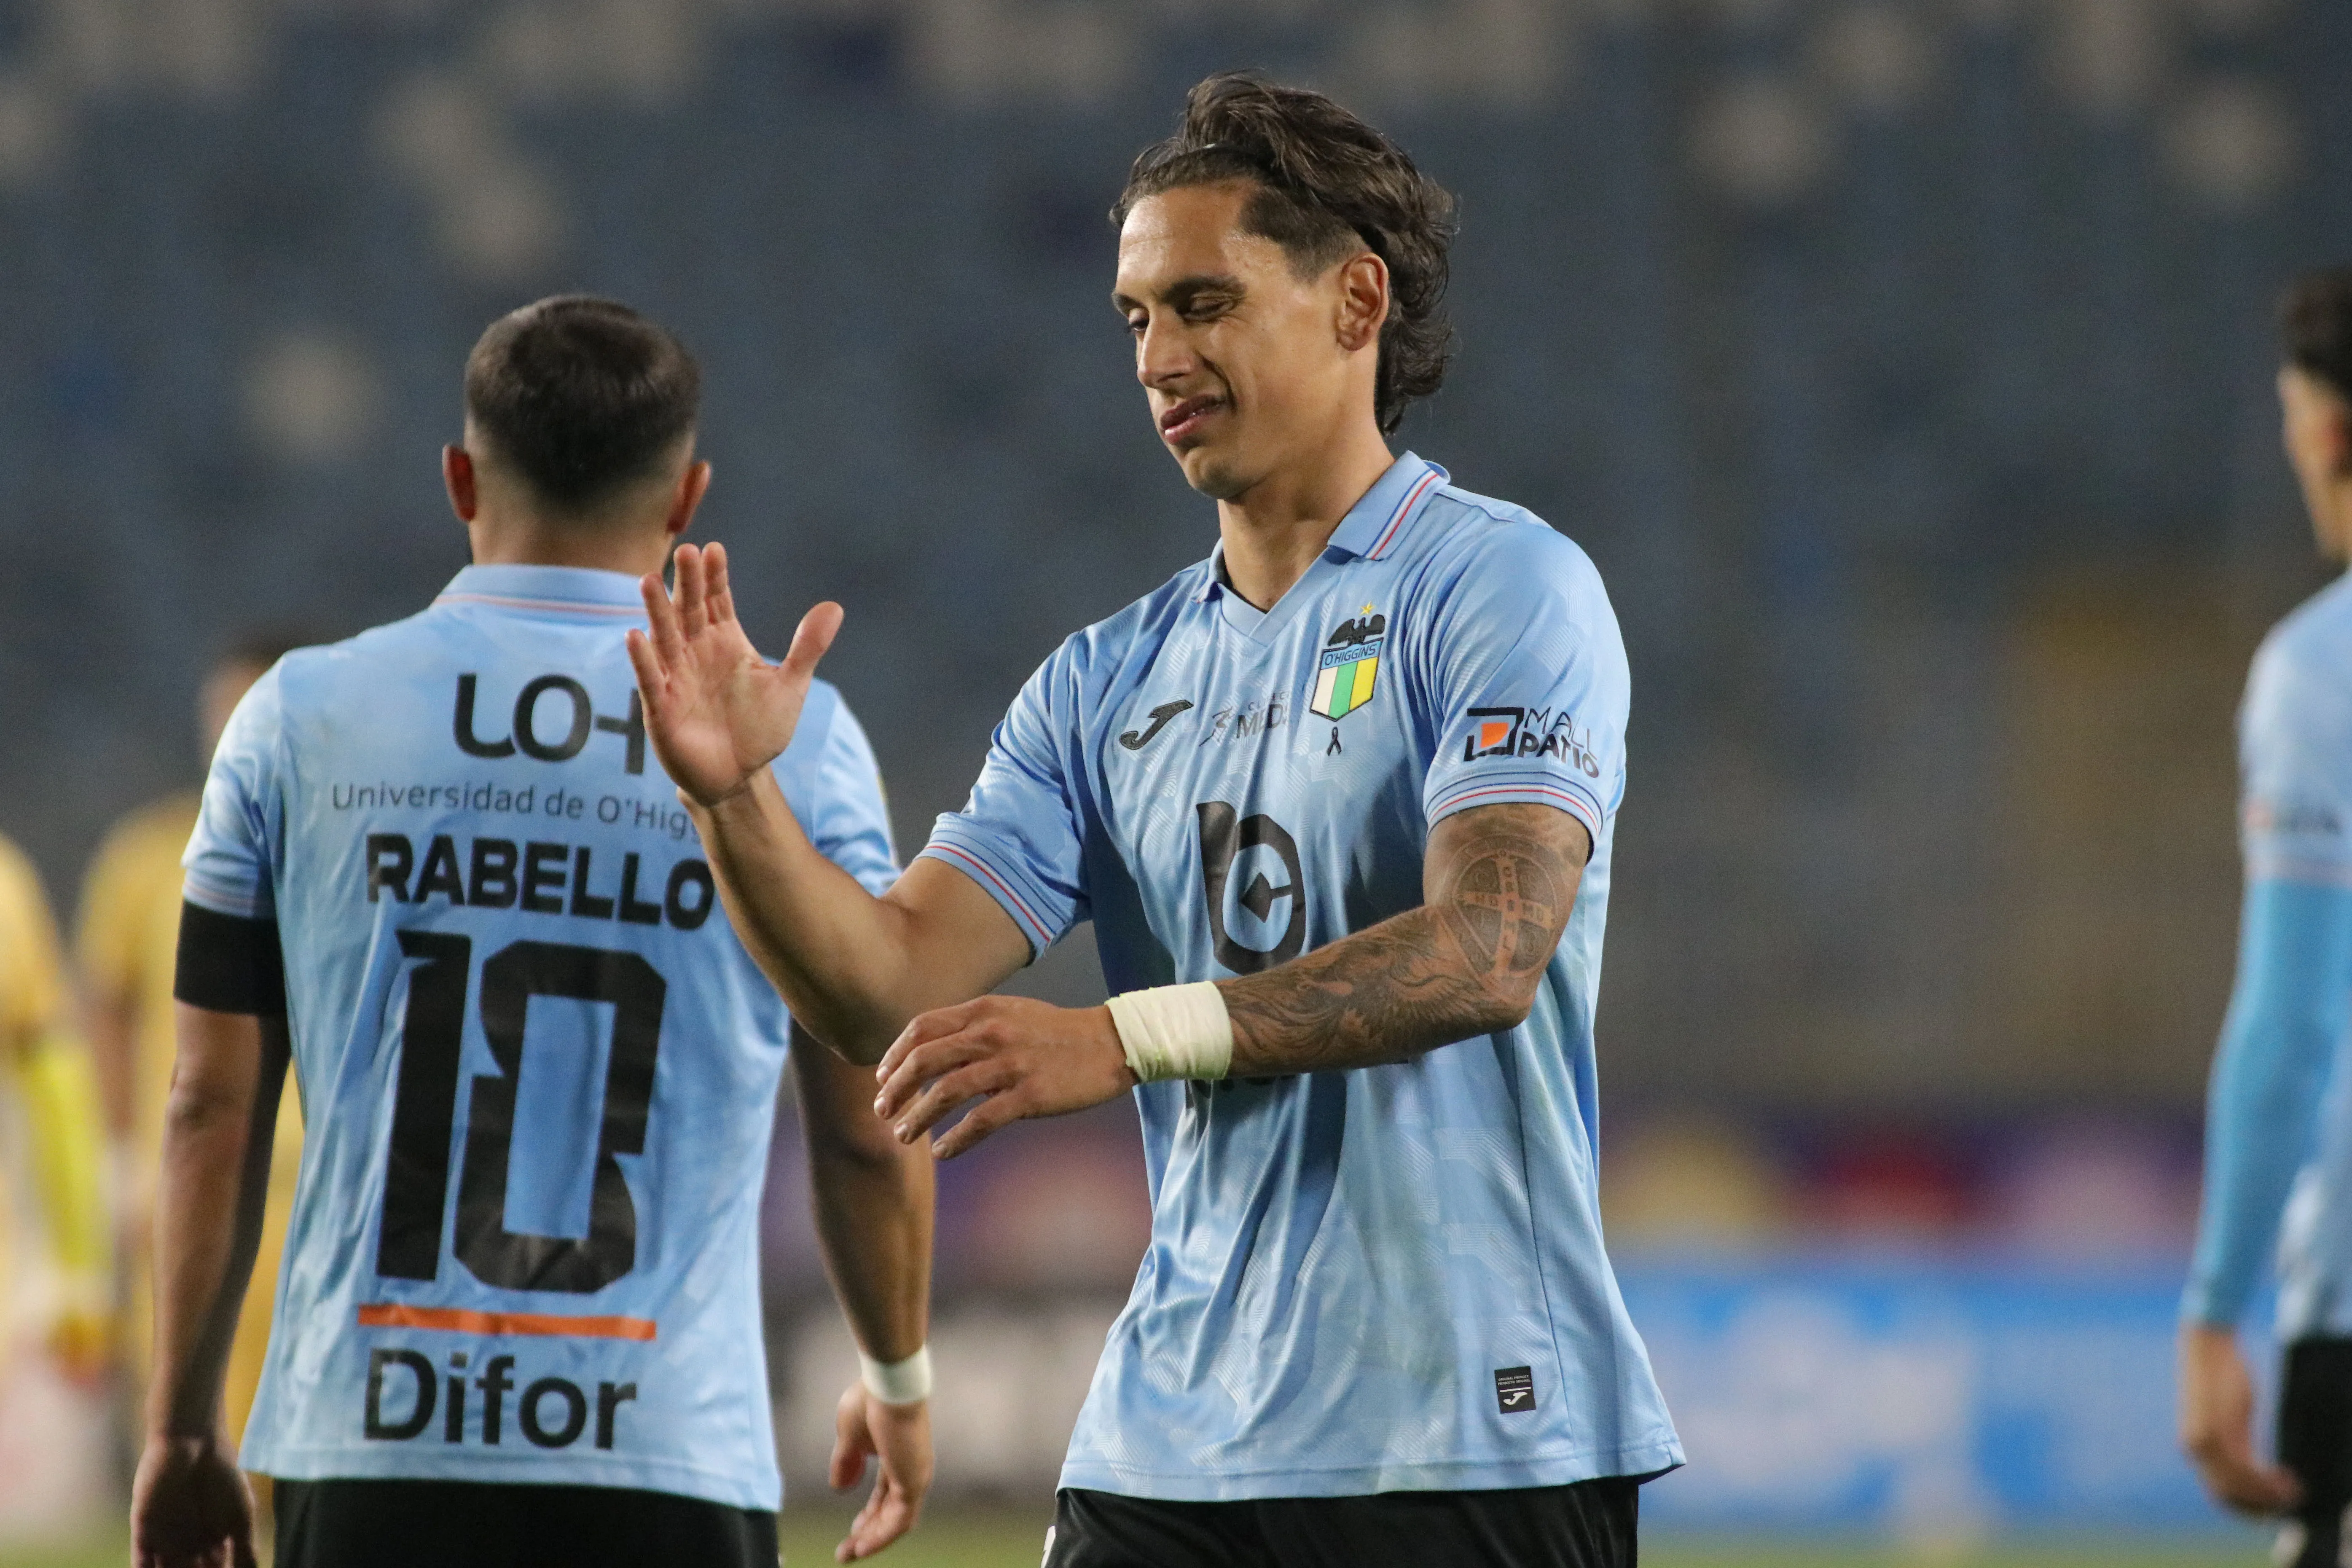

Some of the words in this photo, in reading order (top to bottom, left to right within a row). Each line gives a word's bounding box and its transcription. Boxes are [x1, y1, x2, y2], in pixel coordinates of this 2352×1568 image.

[1324, 644, 1377, 665] O'HIGGINS
[1517, 731, 1599, 778] PATIO
[1524, 706, 1597, 760] MALL
[332, 783, 535, 815] Universidad
[544, 787, 584, 819] de
[366, 832, 715, 930] RABELLO
[375, 928, 667, 1294] 10
[363, 1348, 637, 1450] Difor
